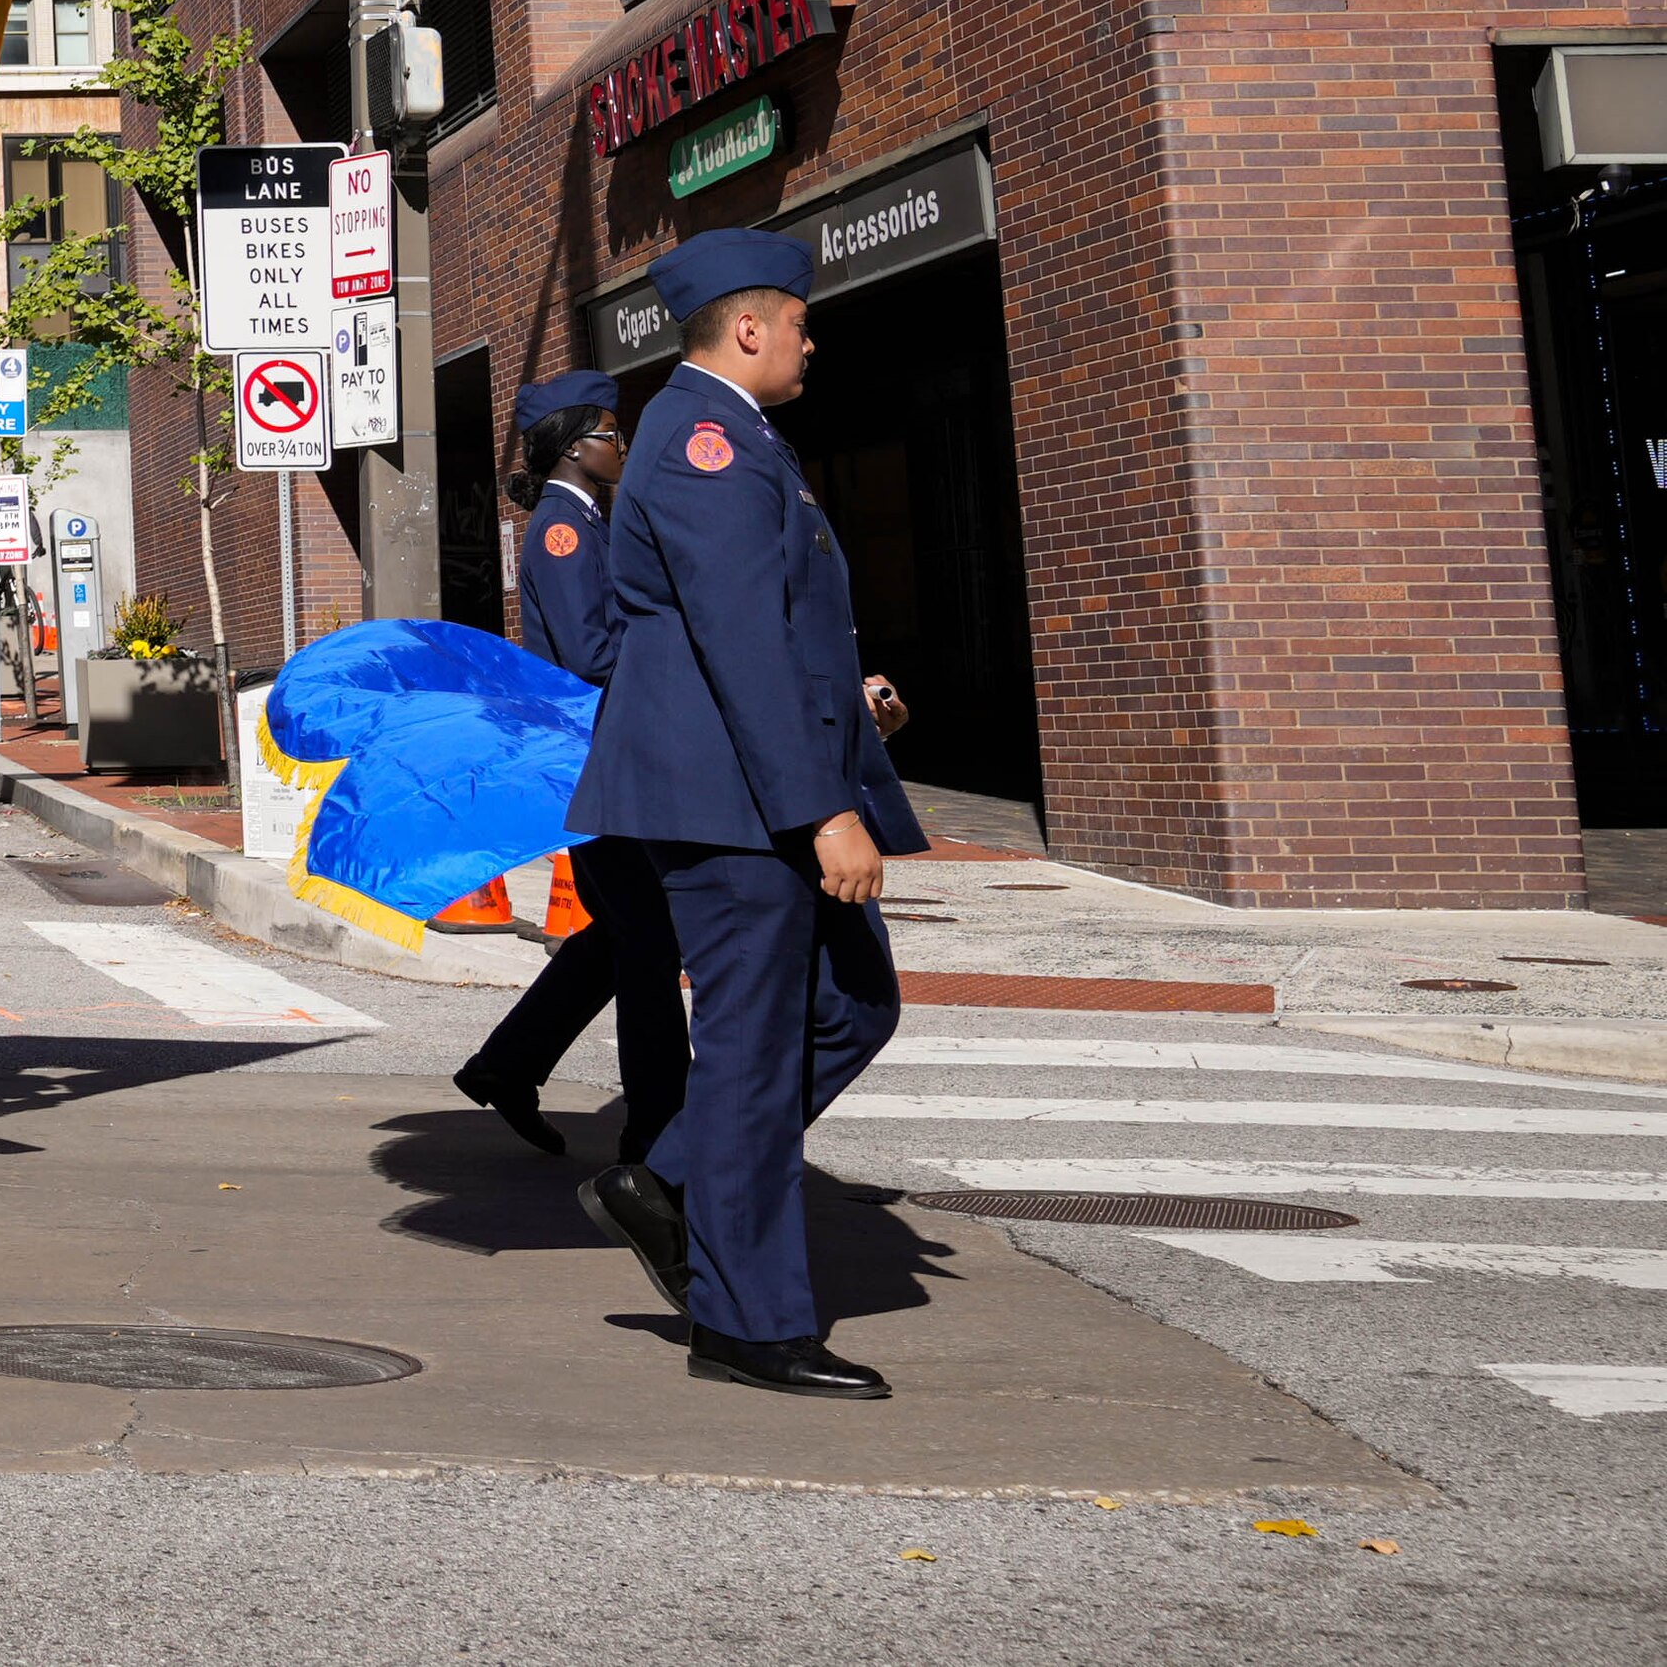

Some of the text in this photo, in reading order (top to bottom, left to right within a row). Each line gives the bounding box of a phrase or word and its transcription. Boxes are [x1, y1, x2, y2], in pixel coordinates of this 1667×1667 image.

[693, 110, 770, 176] TOBACCO
[250, 156, 295, 177] BUS
[245, 179, 302, 201] LANE
[348, 169, 371, 195] NO
[240, 216, 309, 236] BUSES
[335, 205, 386, 235] STOPPING
[821, 187, 940, 265] Accessories
[246, 241, 306, 259] BIKES
[249, 265, 303, 285] ONLY
[337, 278, 386, 293] TOW AWAY ZONE
[258, 291, 298, 310] ALL
[249, 316, 309, 335] TIMES
[617, 301, 660, 348] Cigars
[5, 358, 17, 371] 4
[341, 368, 386, 389] PAY TO
[247, 438, 322, 459] OVER 3/4 TON
[5, 550, 24, 559] ZONE
